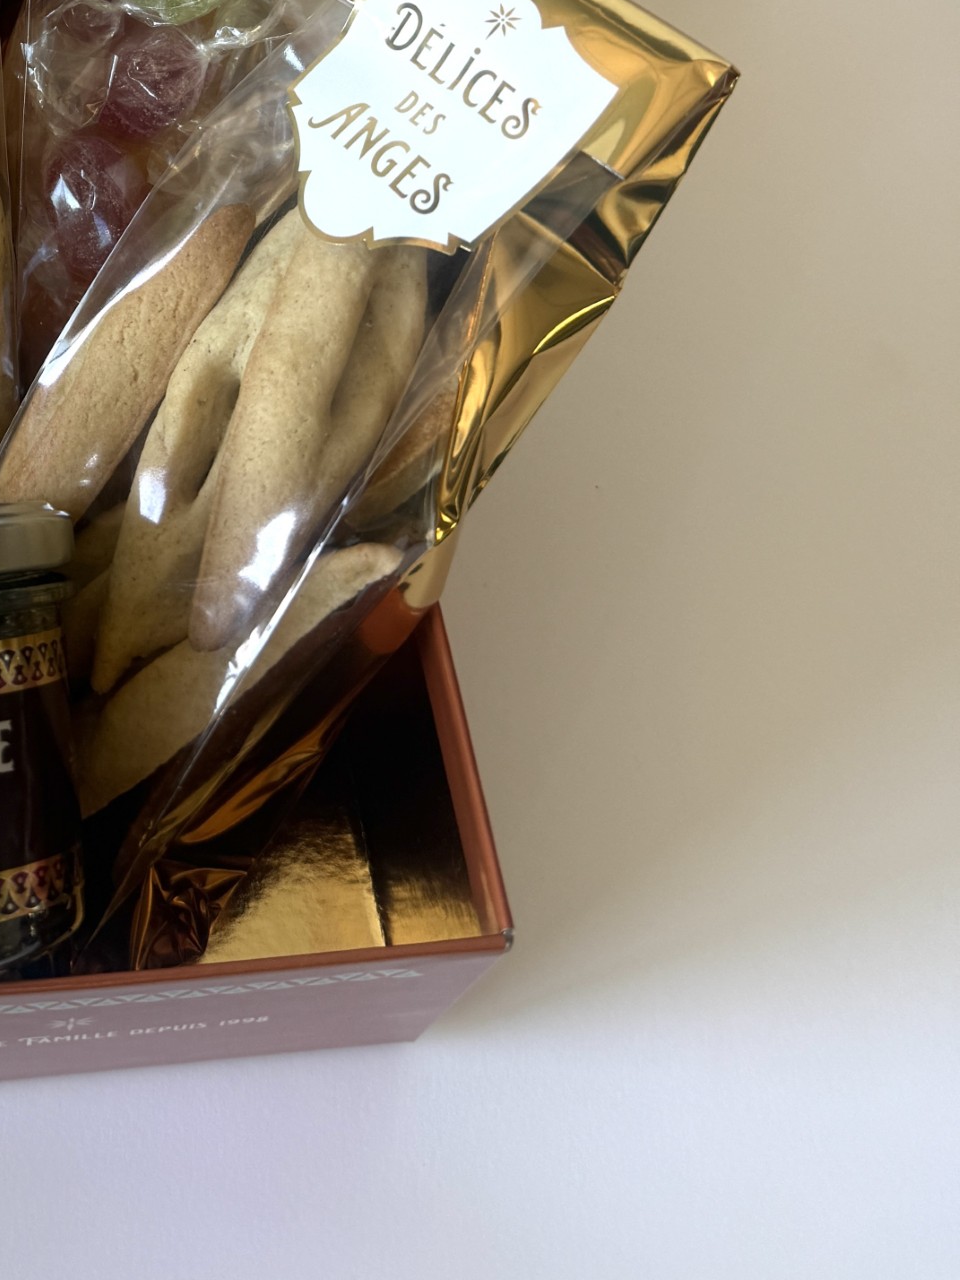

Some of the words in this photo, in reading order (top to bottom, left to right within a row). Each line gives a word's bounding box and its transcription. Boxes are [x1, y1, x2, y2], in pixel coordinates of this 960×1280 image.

[384, 2, 542, 140] DÉLICES
[394, 90, 446, 136] DES
[307, 101, 454, 215] ANGES
[129, 1021, 207, 1036] DEPUIS
